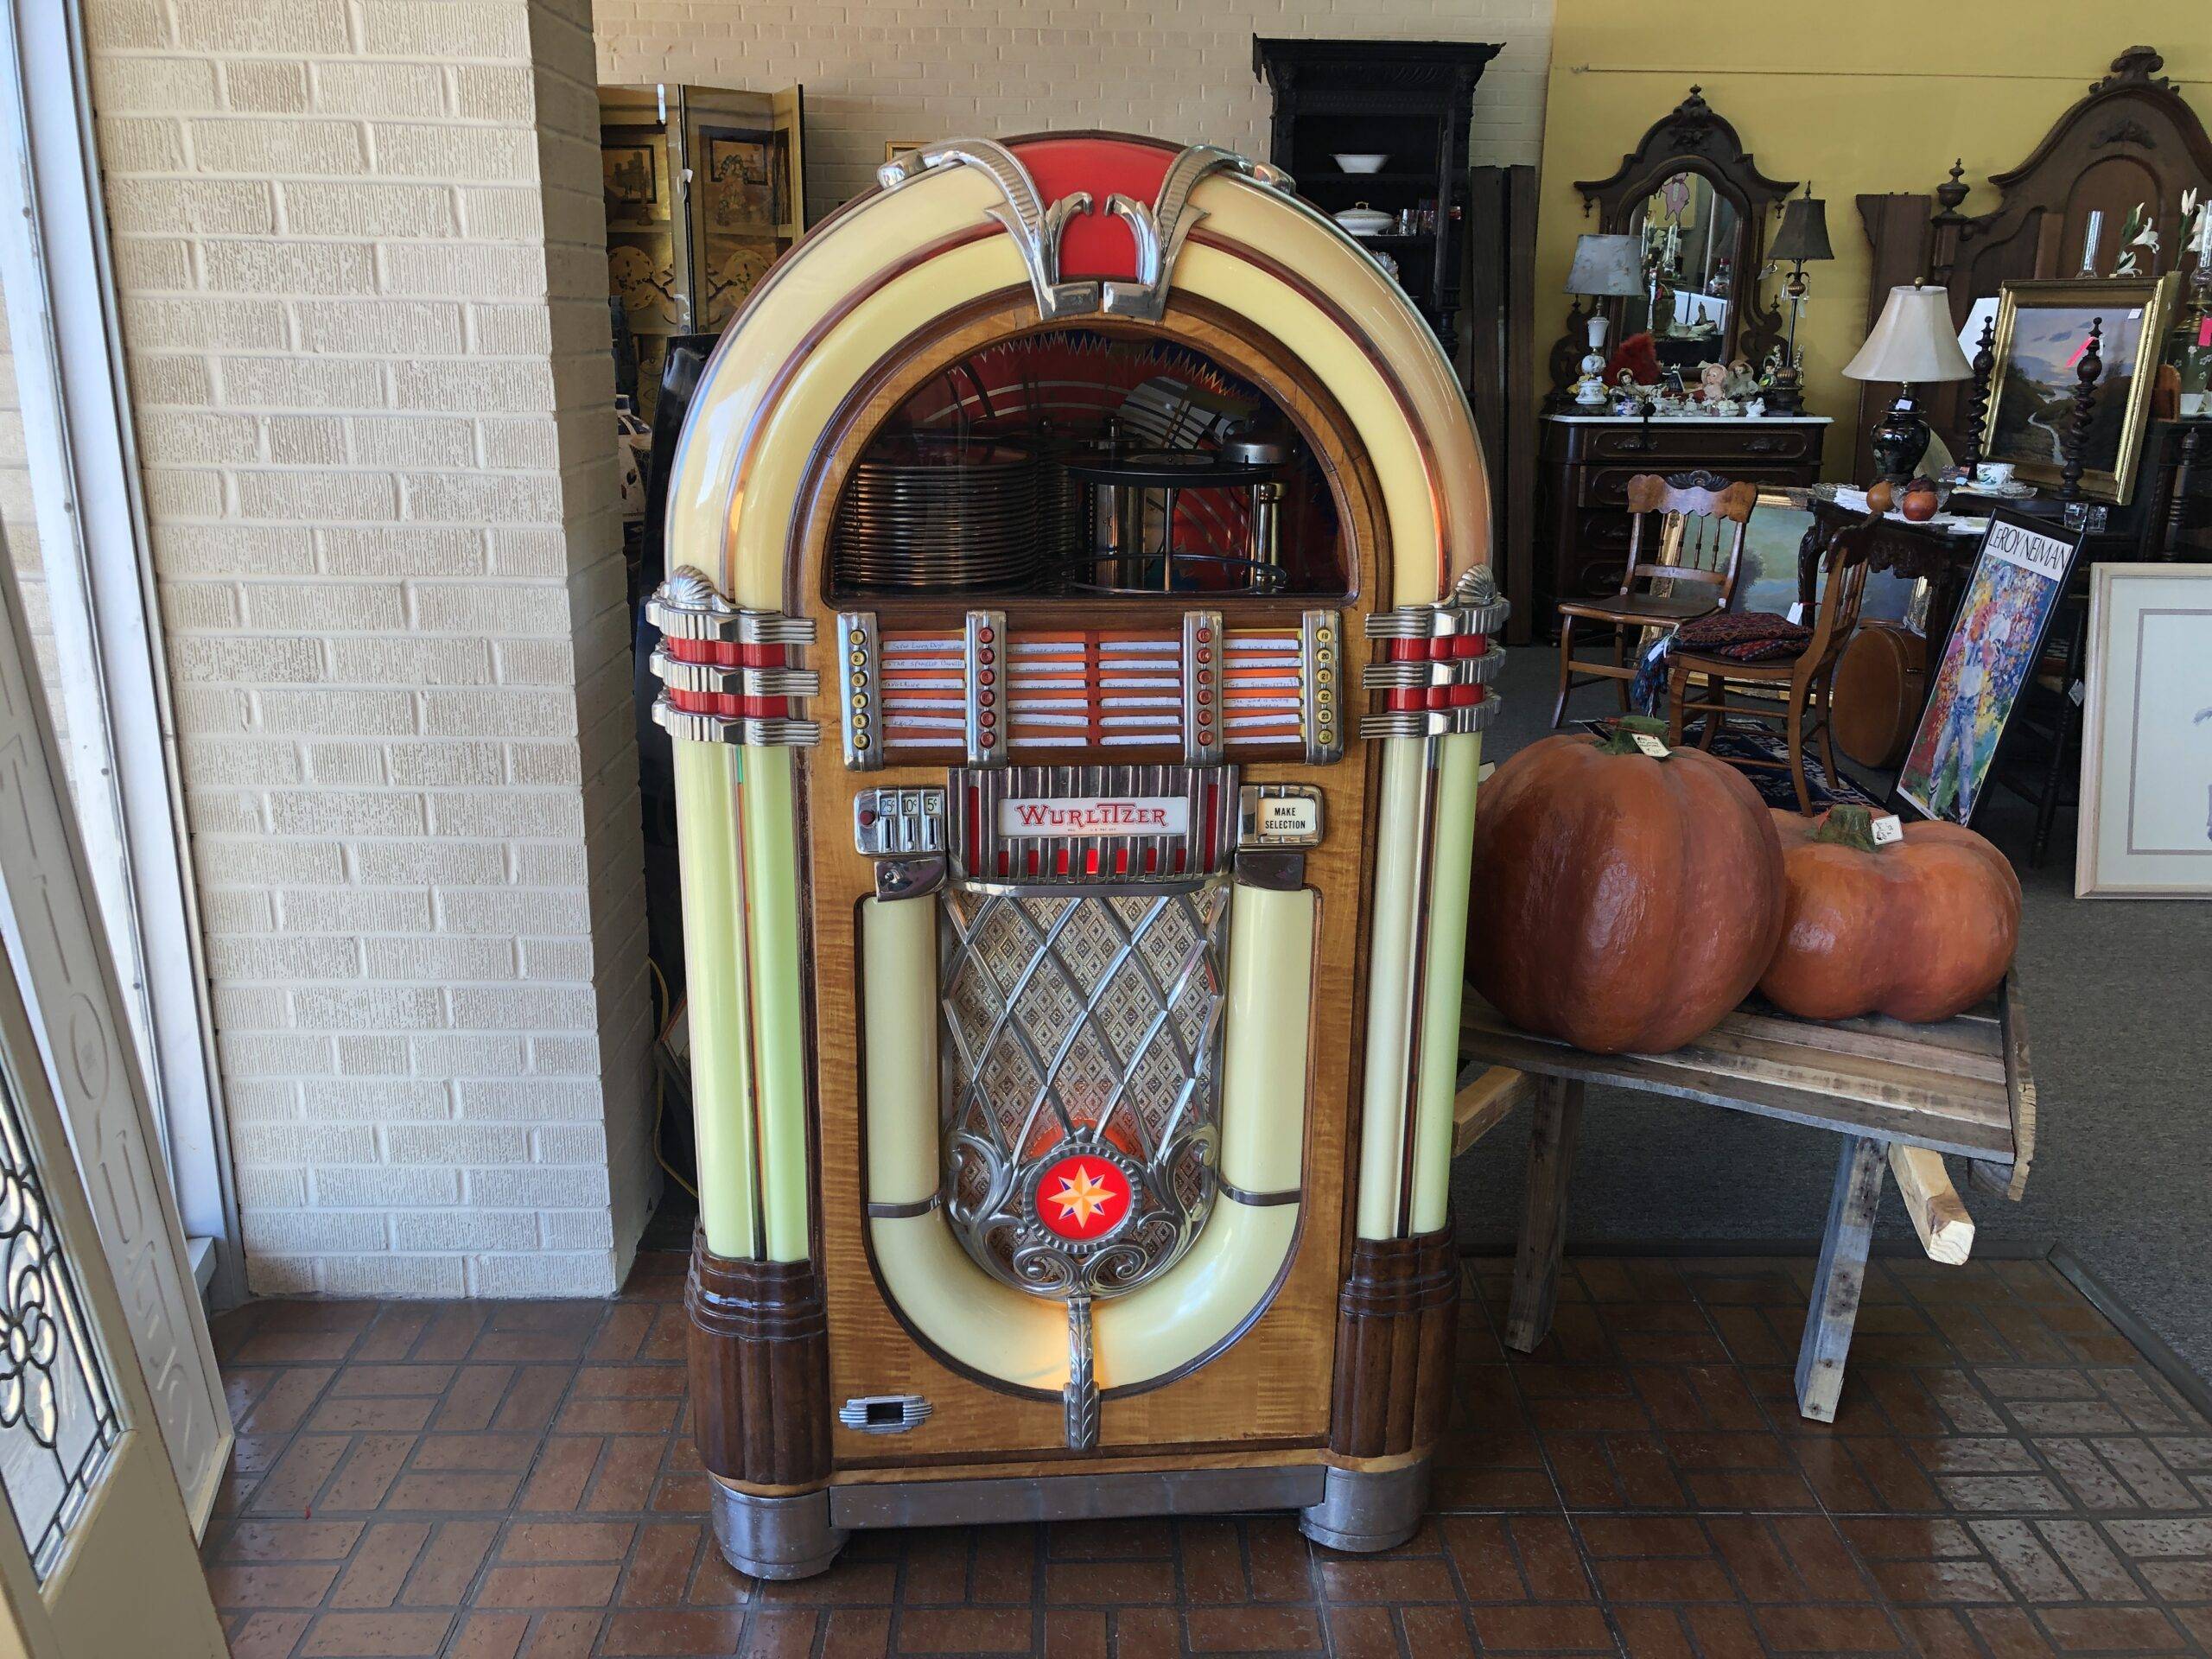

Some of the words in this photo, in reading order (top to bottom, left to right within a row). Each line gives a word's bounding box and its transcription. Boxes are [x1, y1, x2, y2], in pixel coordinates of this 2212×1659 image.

[2020, 536, 2072, 570] NEIMAN
[903, 799, 917, 812] 10¢
[927, 798, 938, 811] 5¢
[1015, 802, 1168, 829] WURLITZER
[1274, 807, 1296, 817] MAKE
[1265, 820, 1306, 830] SELECTION
